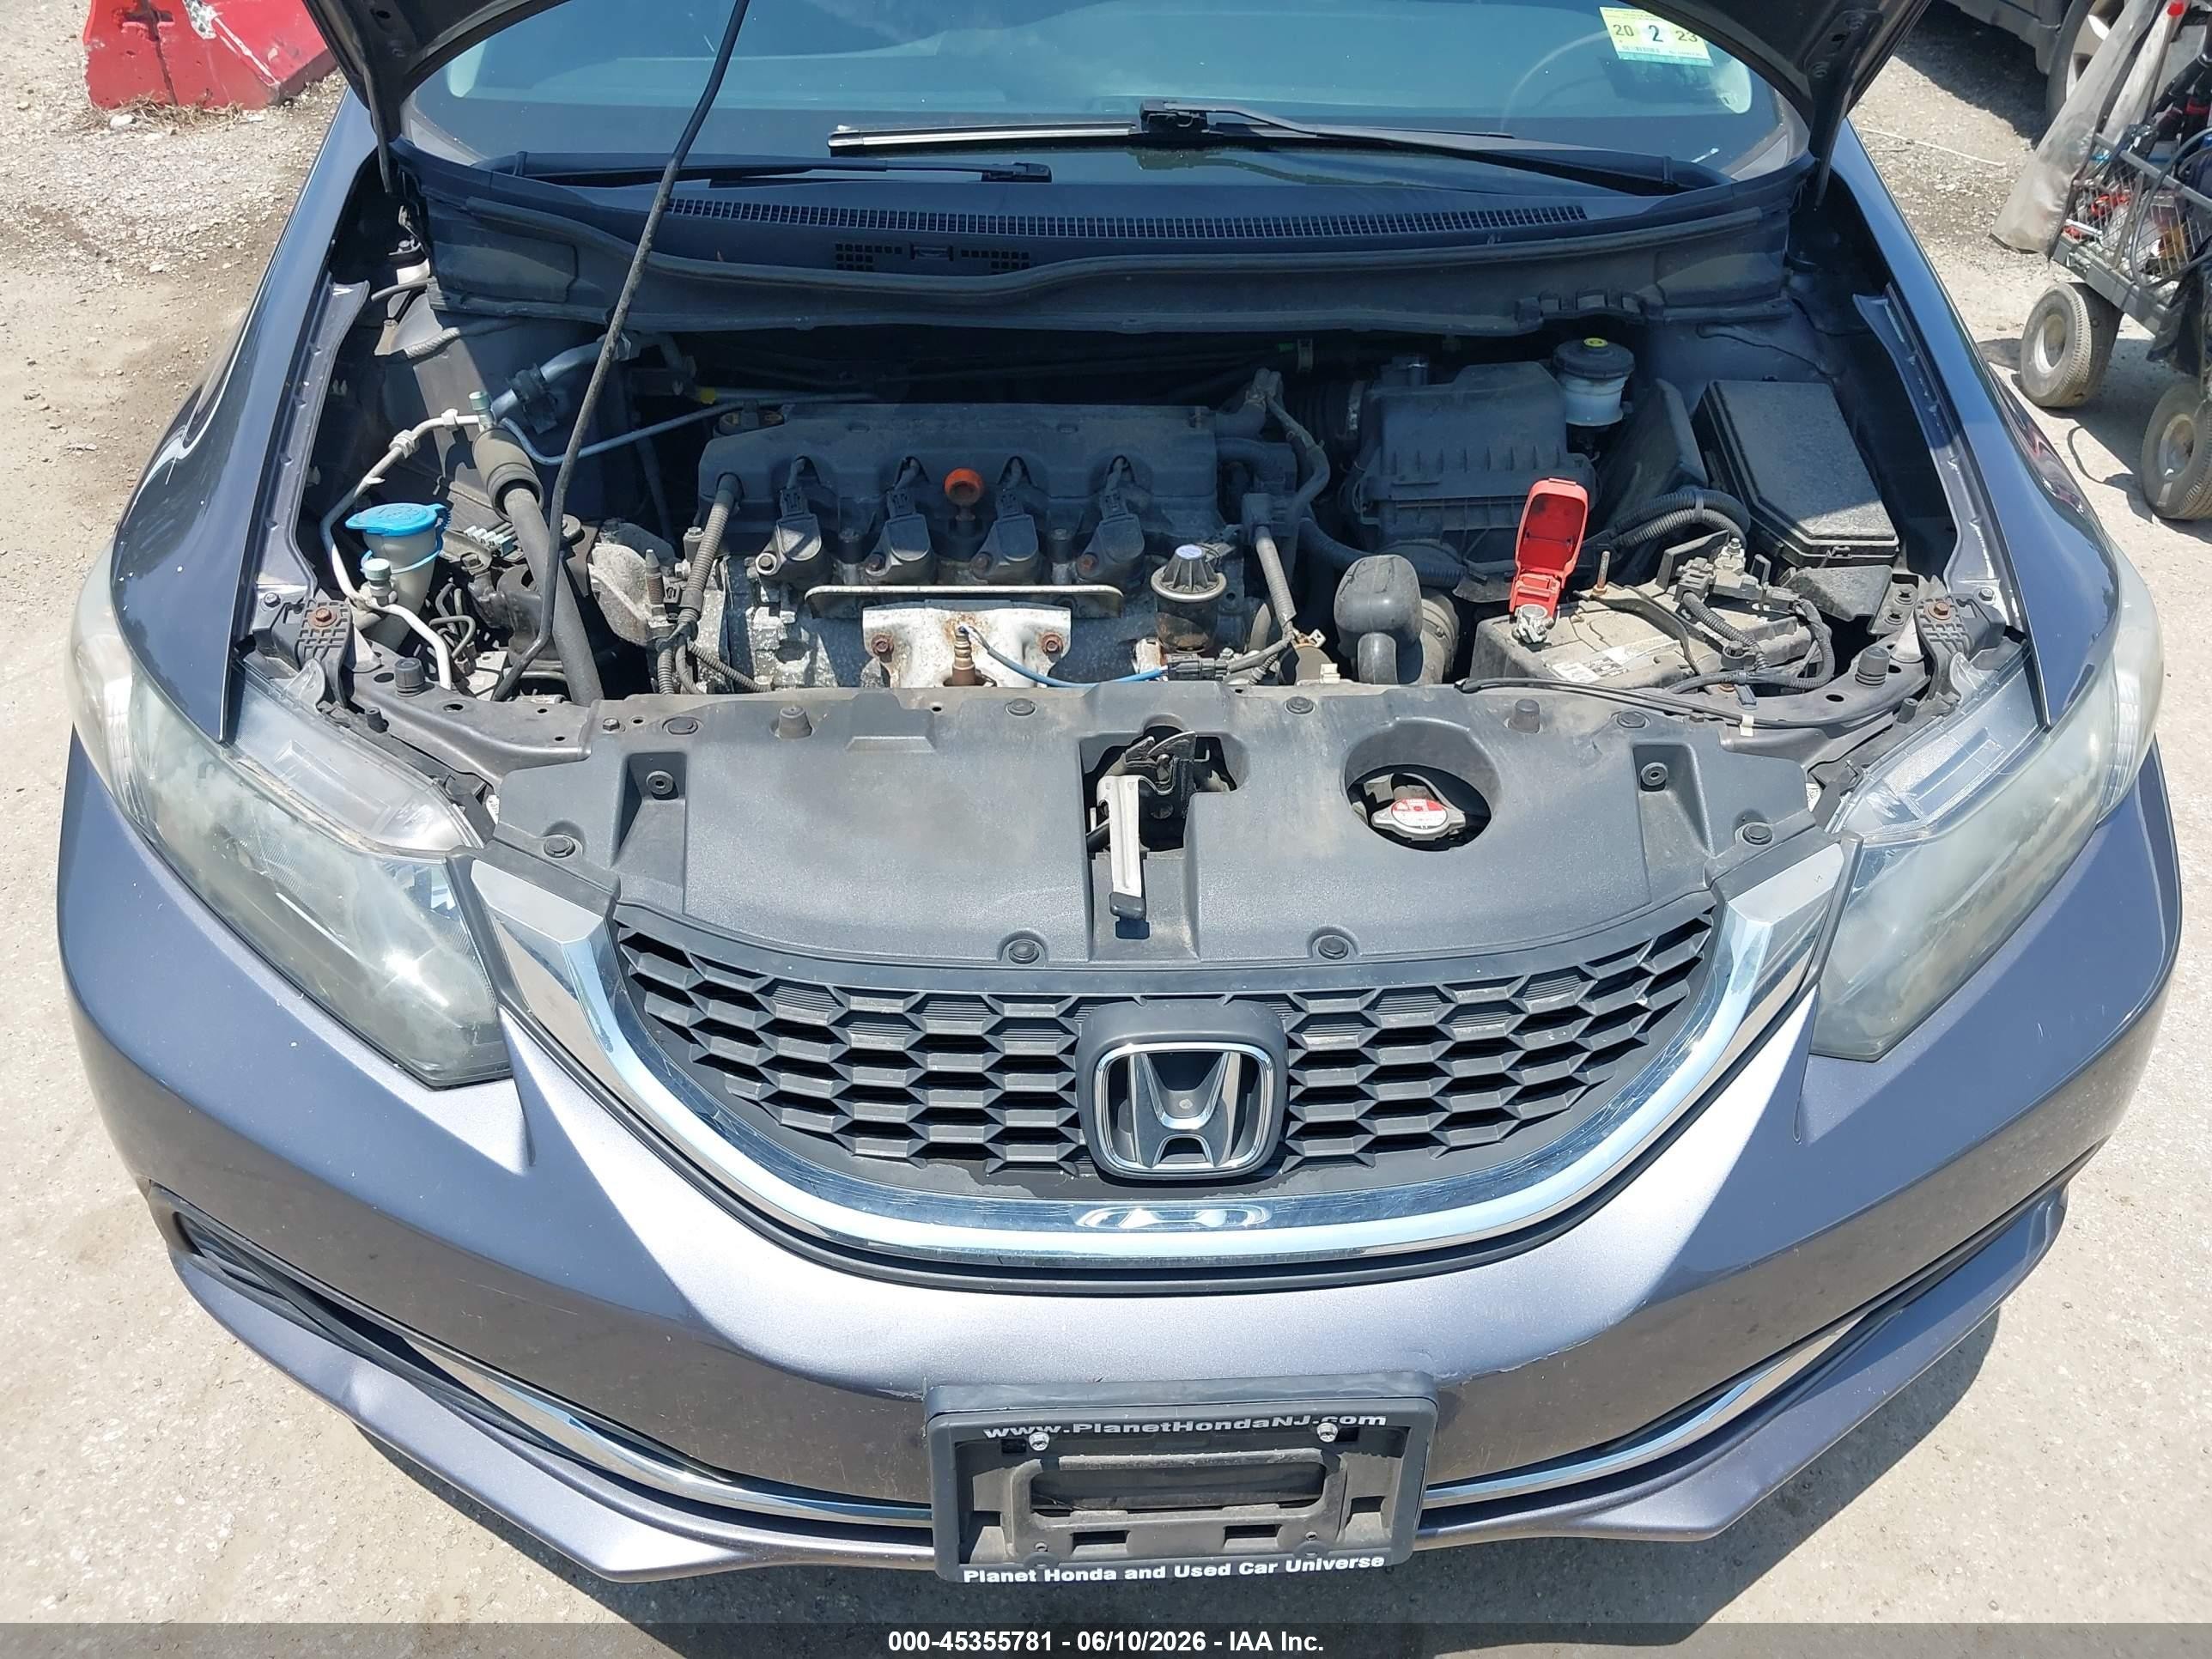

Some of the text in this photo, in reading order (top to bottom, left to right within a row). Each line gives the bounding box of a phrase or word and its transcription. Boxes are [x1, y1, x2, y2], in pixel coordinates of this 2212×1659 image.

[1613, 24, 1698, 43] 20 2 23
[983, 1415, 1387, 1439] www.PlanetHondaNJ.com
[963, 1556, 1385, 1583] Planet Honda and Used Car Universe
